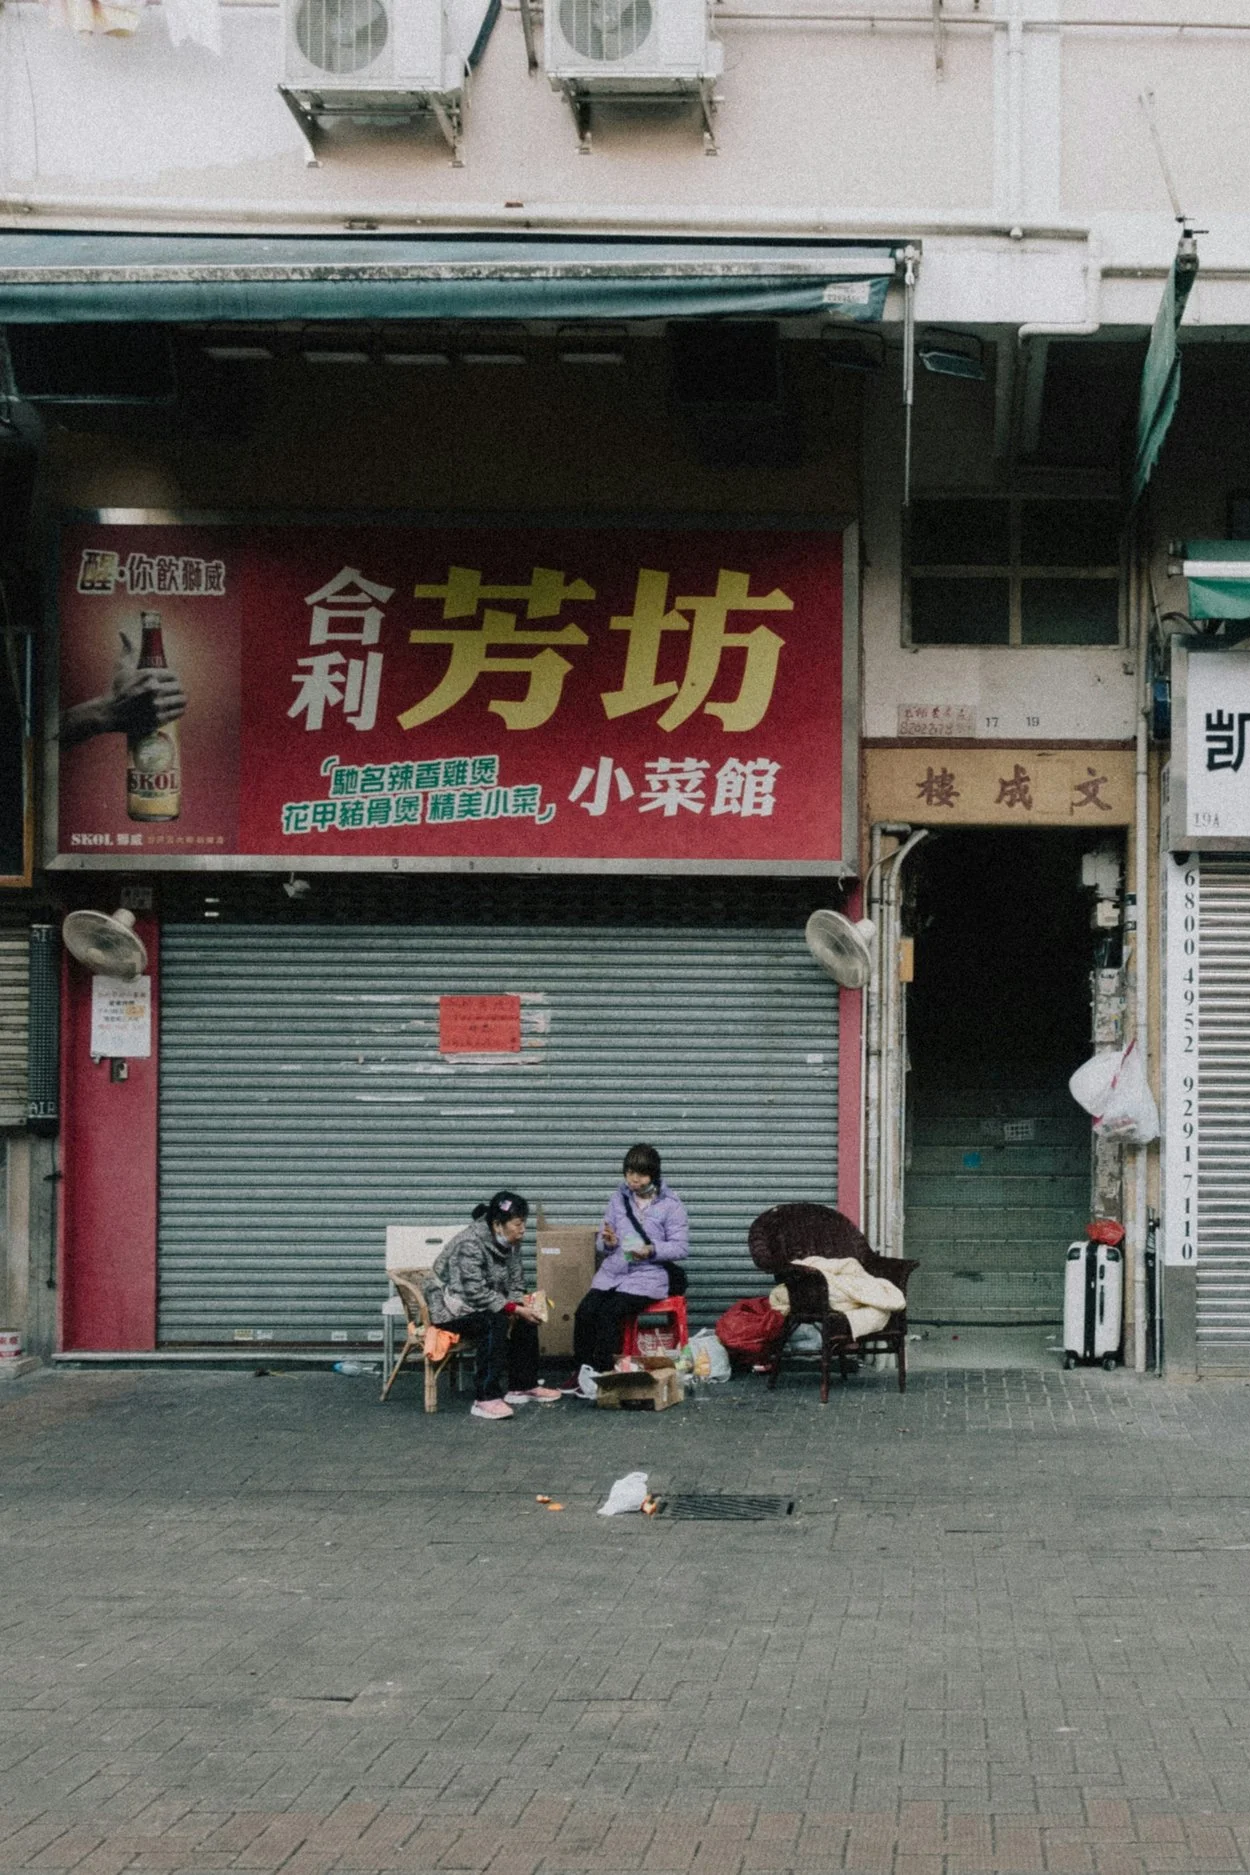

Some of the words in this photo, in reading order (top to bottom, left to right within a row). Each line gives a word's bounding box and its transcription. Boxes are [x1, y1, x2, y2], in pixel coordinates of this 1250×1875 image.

[287, 565, 396, 732] 合利
[397, 566, 794, 733] 芳坊
[985, 716, 999, 728] 17
[1026, 716, 1040, 728] 19
[128, 771, 179, 791] SKOL
[567, 755, 783, 818] 小菜館
[1193, 811, 1221, 829] 19A
[70, 833, 114, 846] SKOL
